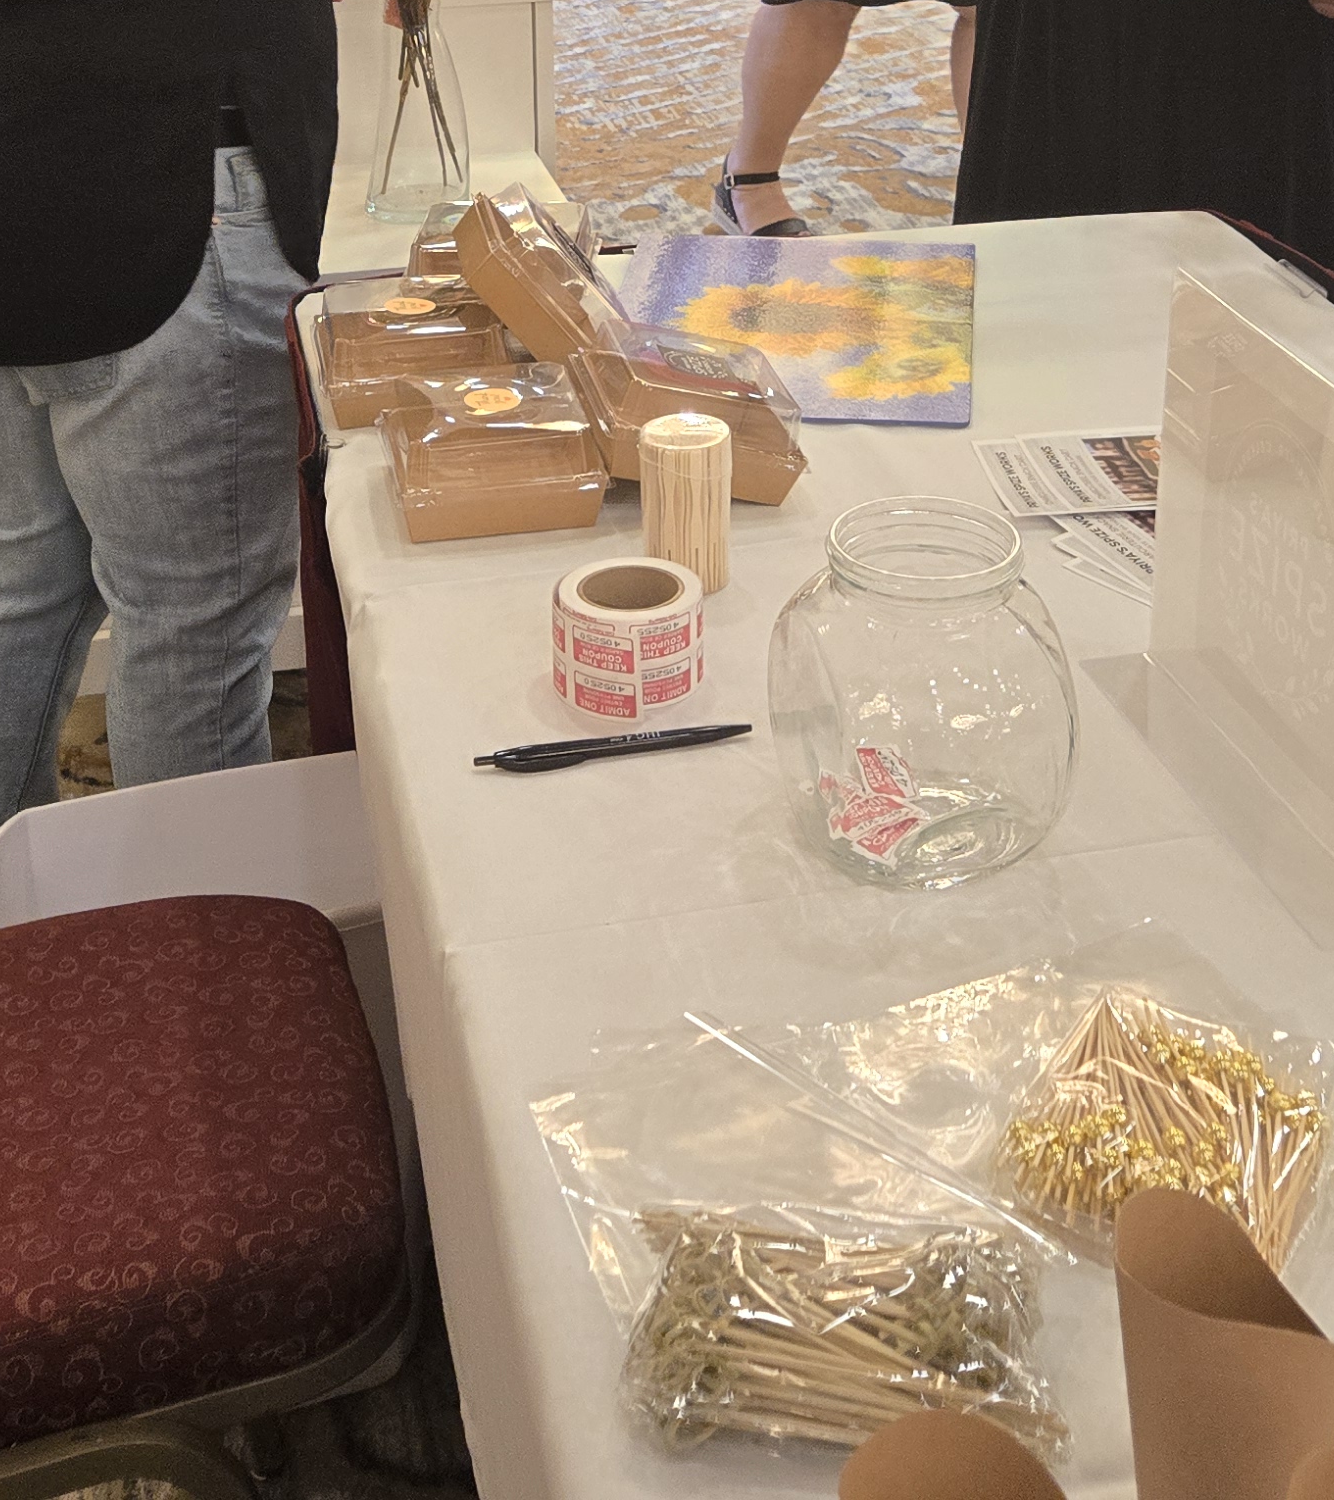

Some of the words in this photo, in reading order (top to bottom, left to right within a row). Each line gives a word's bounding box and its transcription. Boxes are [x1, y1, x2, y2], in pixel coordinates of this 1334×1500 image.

[1089, 527, 1121, 551] SPIZE
[643, 635, 682, 649] COUPON
[663, 640, 686, 654] KEEP
[578, 653, 599, 667] THIS
[582, 648, 622, 663] COUPON
[601, 662, 627, 672] KEEP
[643, 694, 658, 704] ON
[661, 684, 687, 700] ADMIT
[579, 697, 597, 709] ONE
[599, 704, 631, 716] ADMIT
